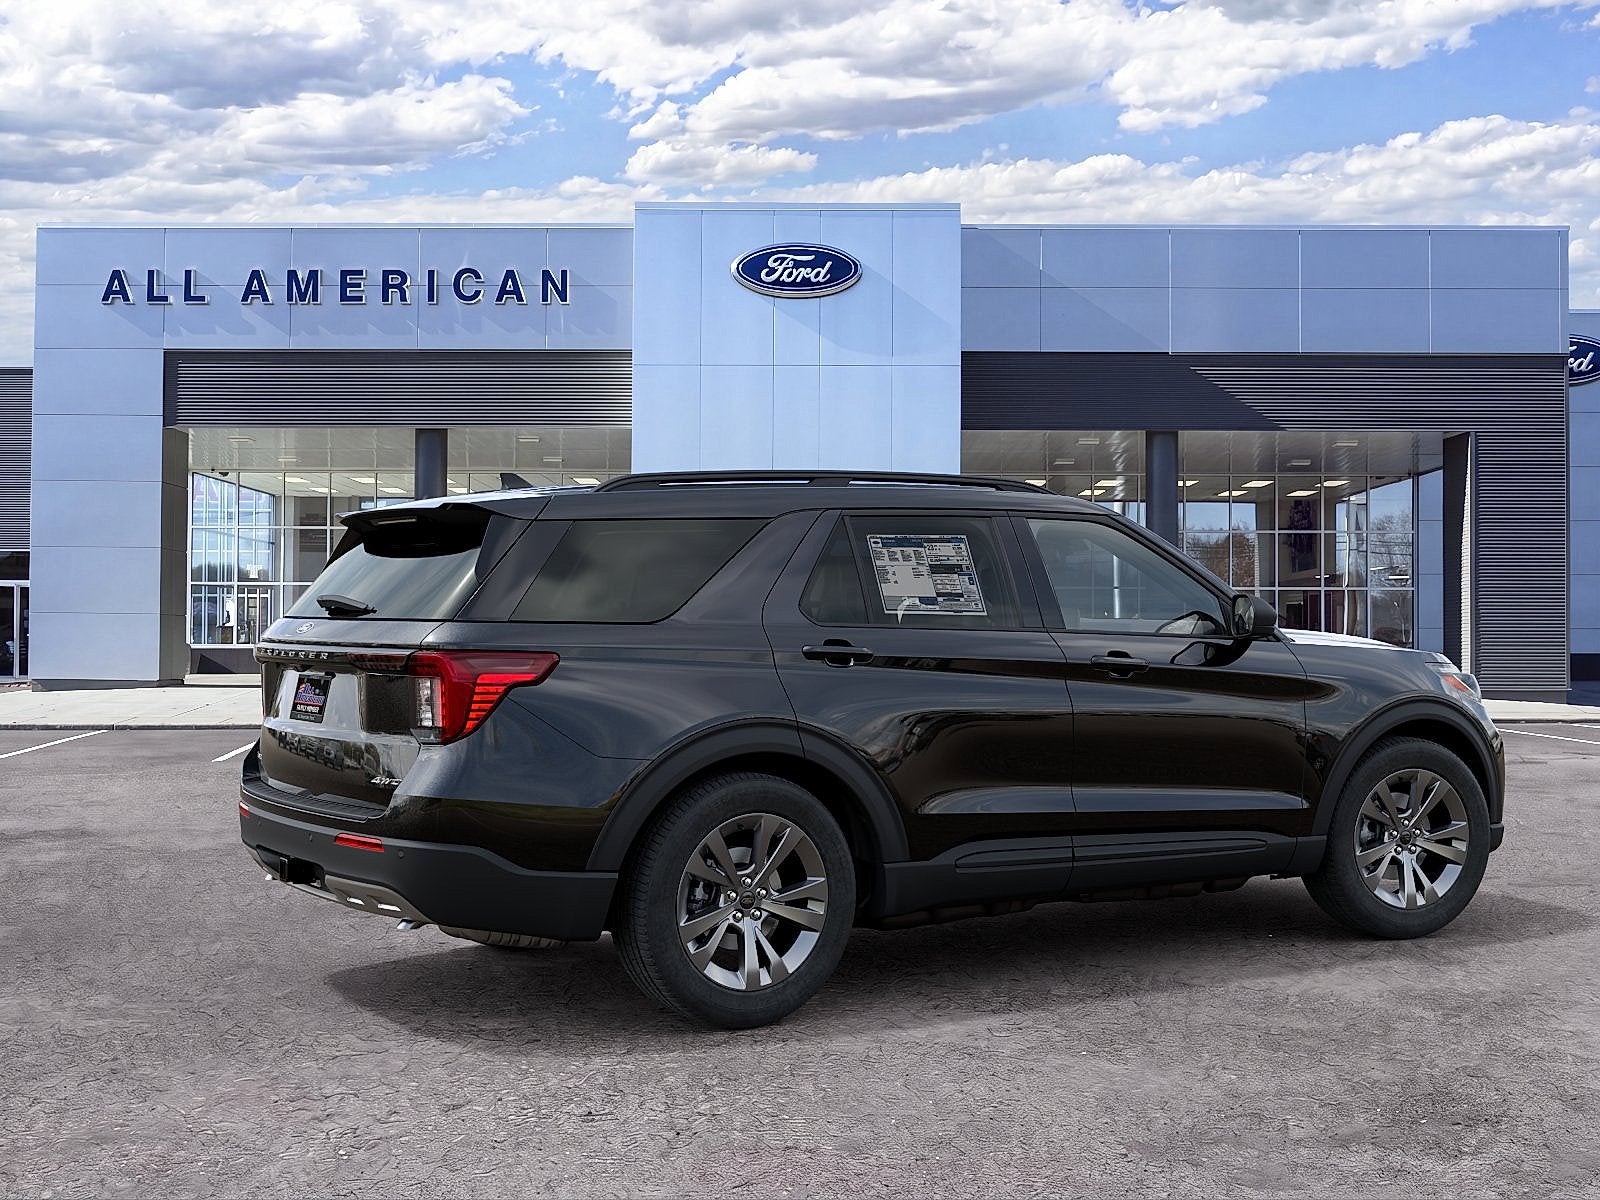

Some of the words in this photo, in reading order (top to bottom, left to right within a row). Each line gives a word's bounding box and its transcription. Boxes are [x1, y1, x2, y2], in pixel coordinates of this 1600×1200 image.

[760, 253, 833, 283] Ford
[101, 269, 208, 304] ALL
[241, 268, 571, 304] AMERICAN
